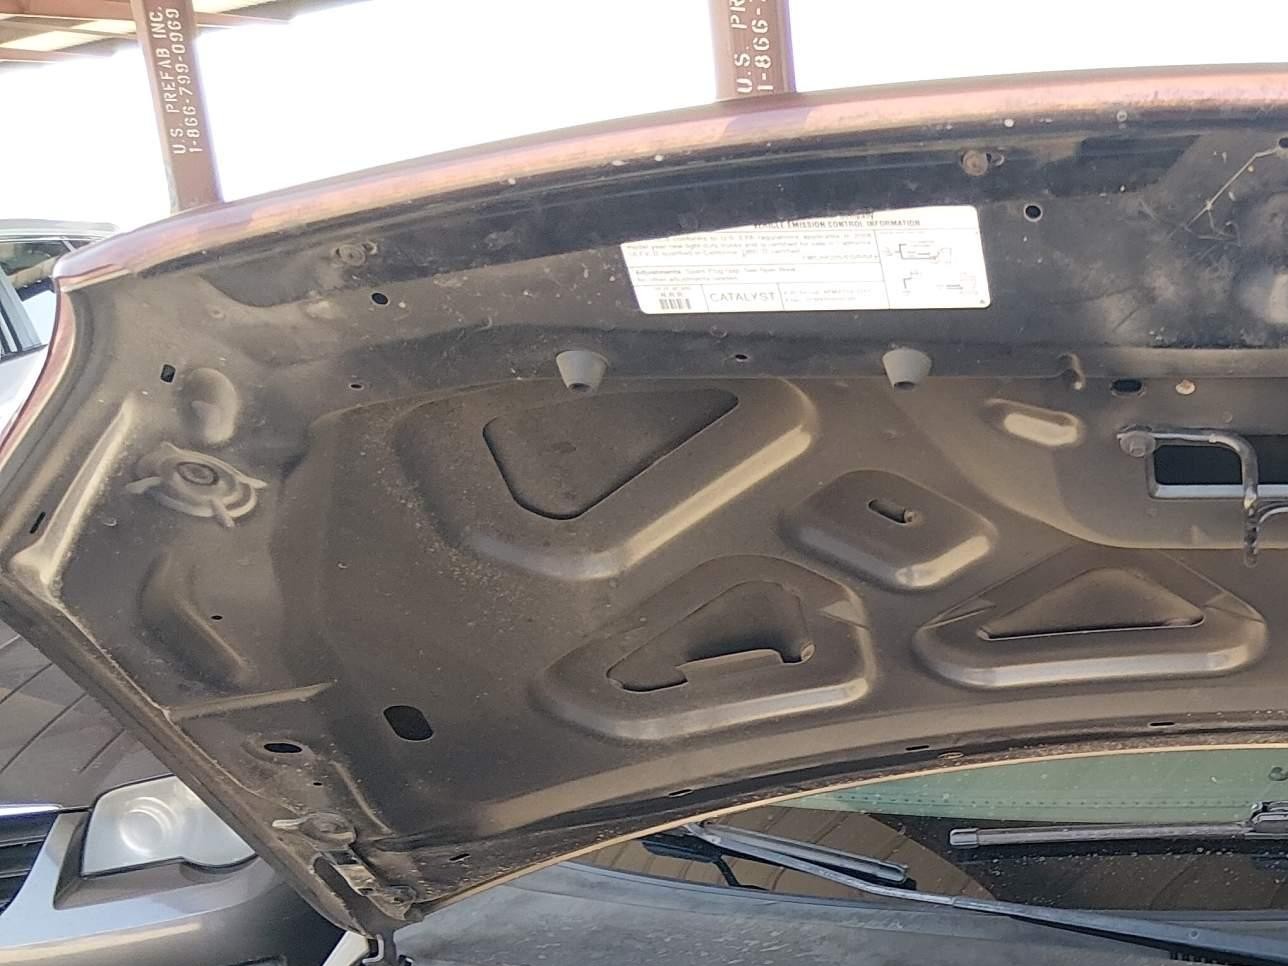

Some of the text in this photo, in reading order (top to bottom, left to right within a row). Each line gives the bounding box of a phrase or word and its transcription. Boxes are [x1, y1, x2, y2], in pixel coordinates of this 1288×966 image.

[149, 6, 167, 38] INC.
[751, 0, 774, 91] 1-866-
[155, 48, 180, 113] PREFAB
[165, 8, 203, 153] 1-866-799-0969
[734, 46, 753, 93] U.S.
[786, 219, 826, 229] EMISSION
[828, 219, 863, 229] CONTROL
[866, 217, 921, 228] INFORMATION
[709, 291, 776, 303] CATALYST
